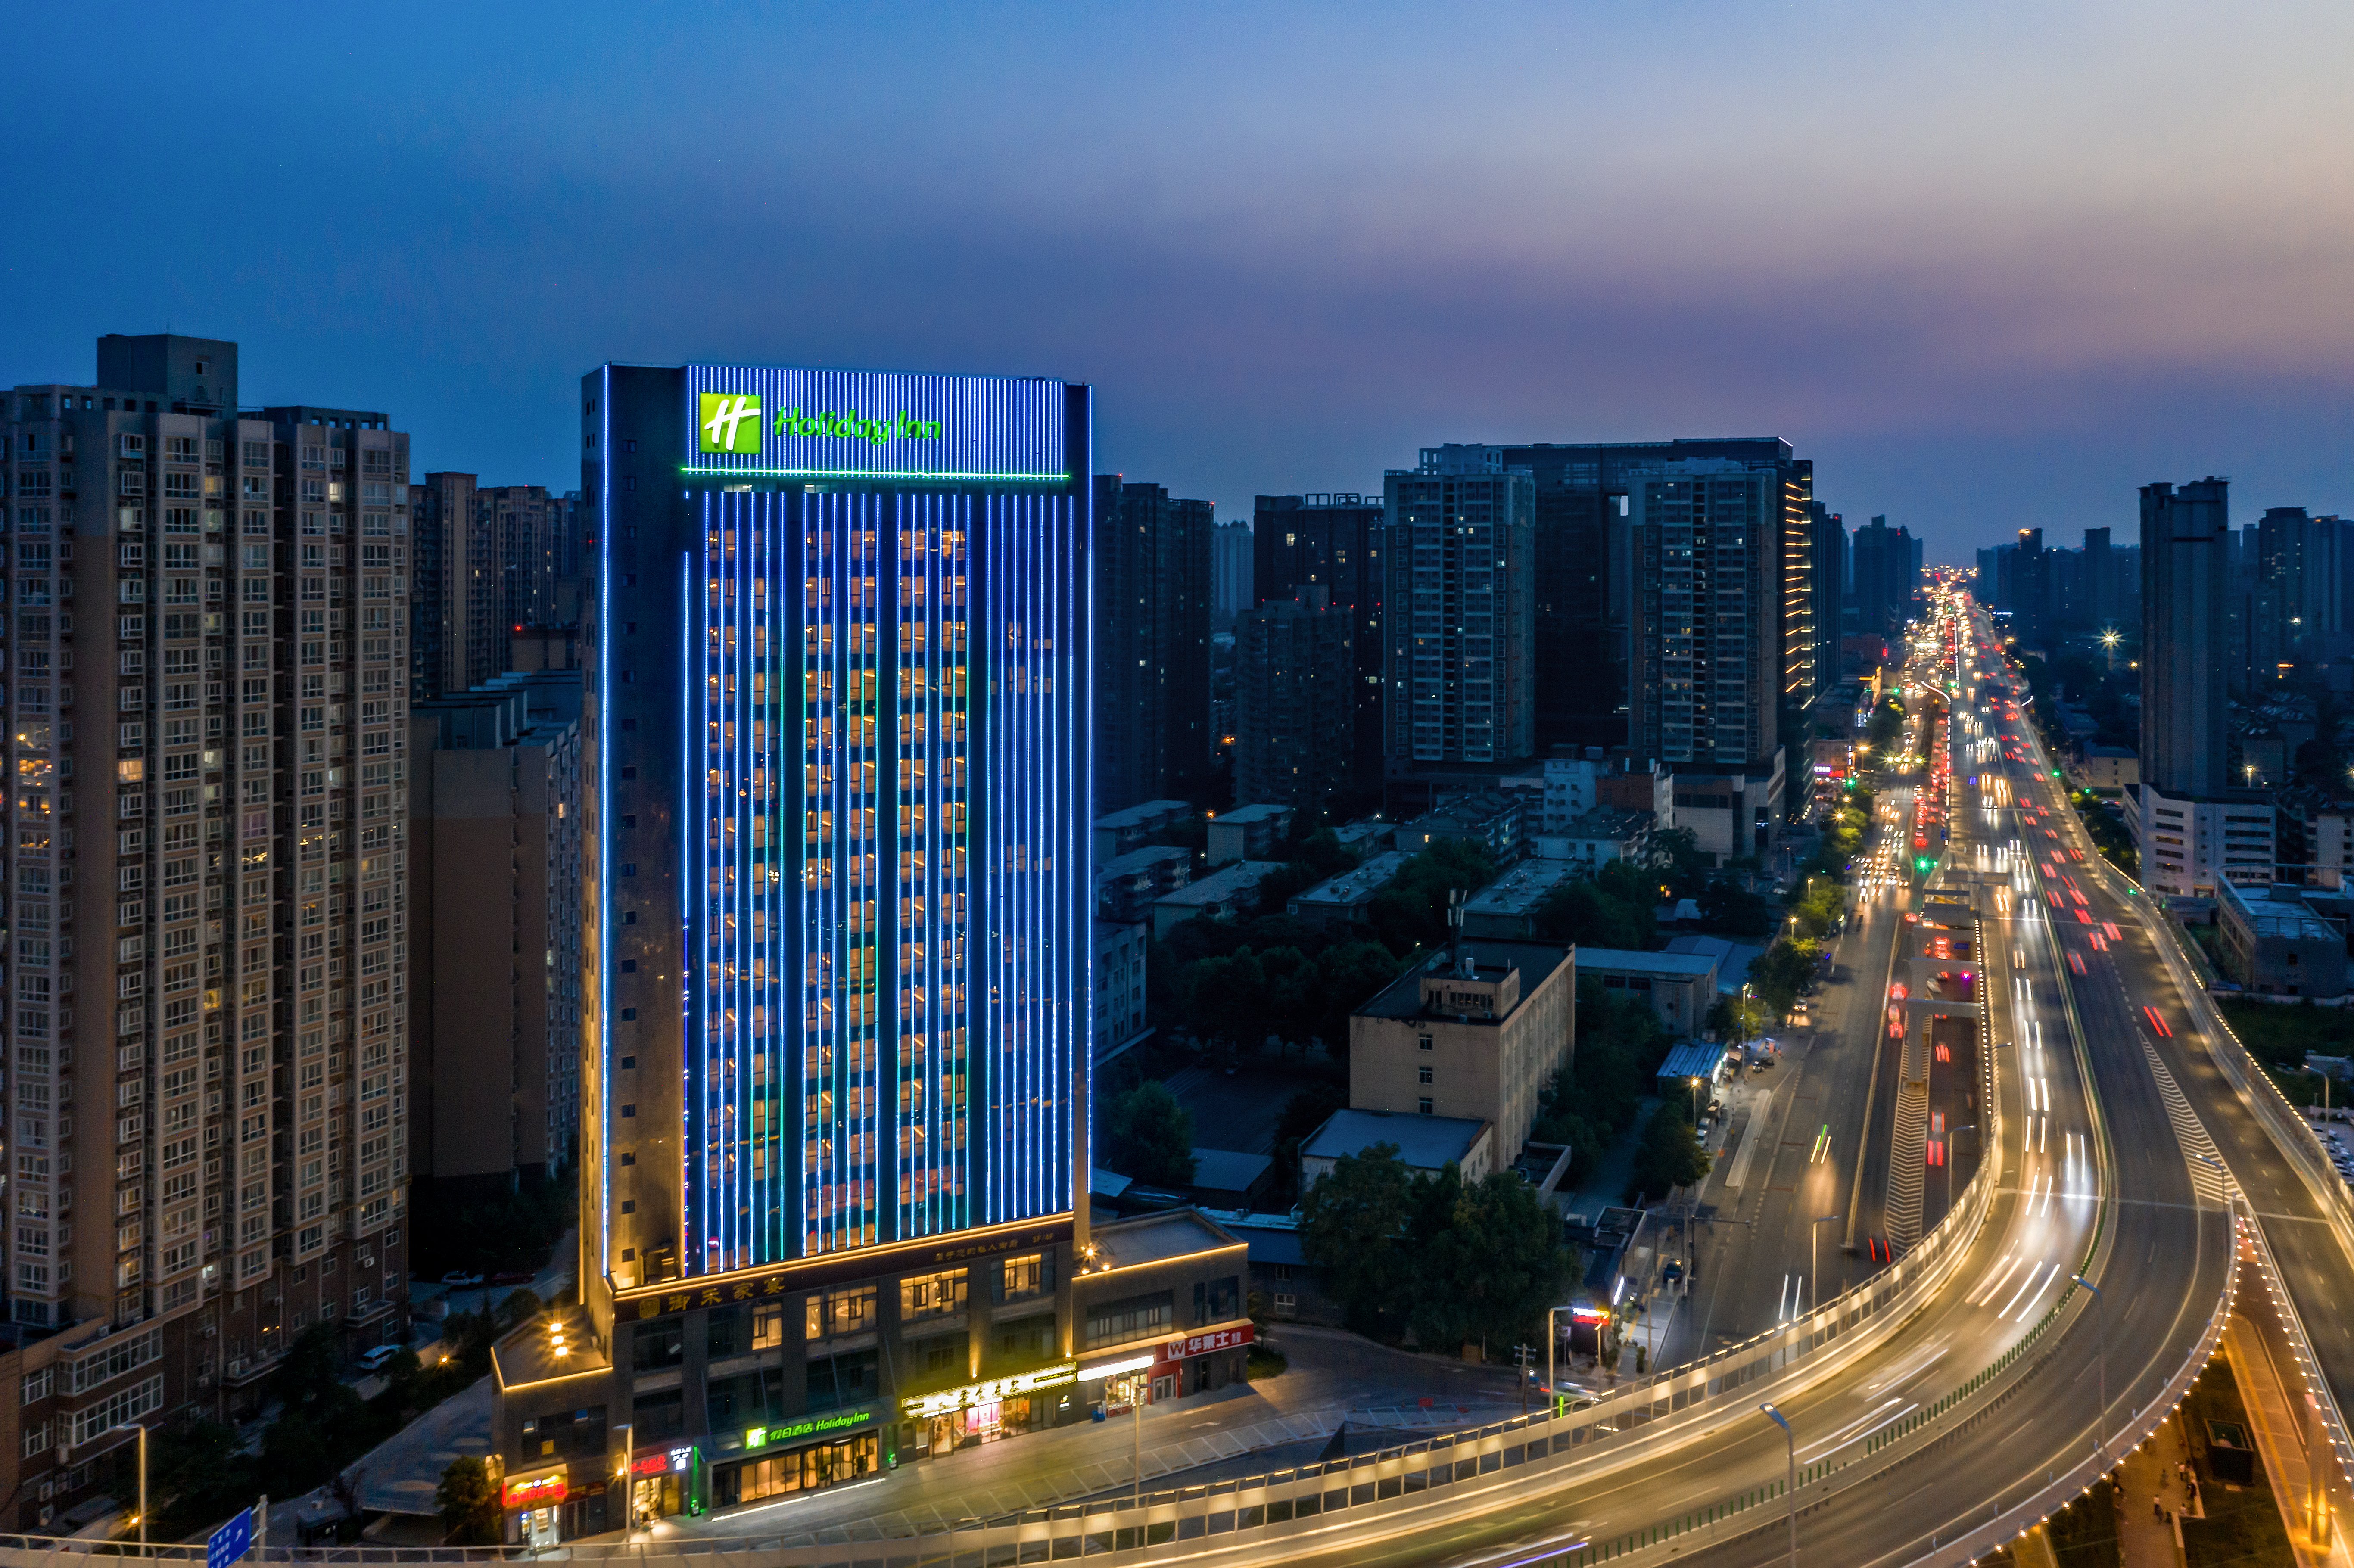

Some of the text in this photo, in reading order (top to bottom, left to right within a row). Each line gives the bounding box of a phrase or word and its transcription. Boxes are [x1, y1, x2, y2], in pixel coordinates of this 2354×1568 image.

[774, 406, 941, 445] Holiday Inn
[669, 1276, 785, 1312] 御禾家宴
[1188, 1332, 1230, 1352] 华莱士
[769, 1412, 870, 1441] 假日酒店 Holiday Inn
